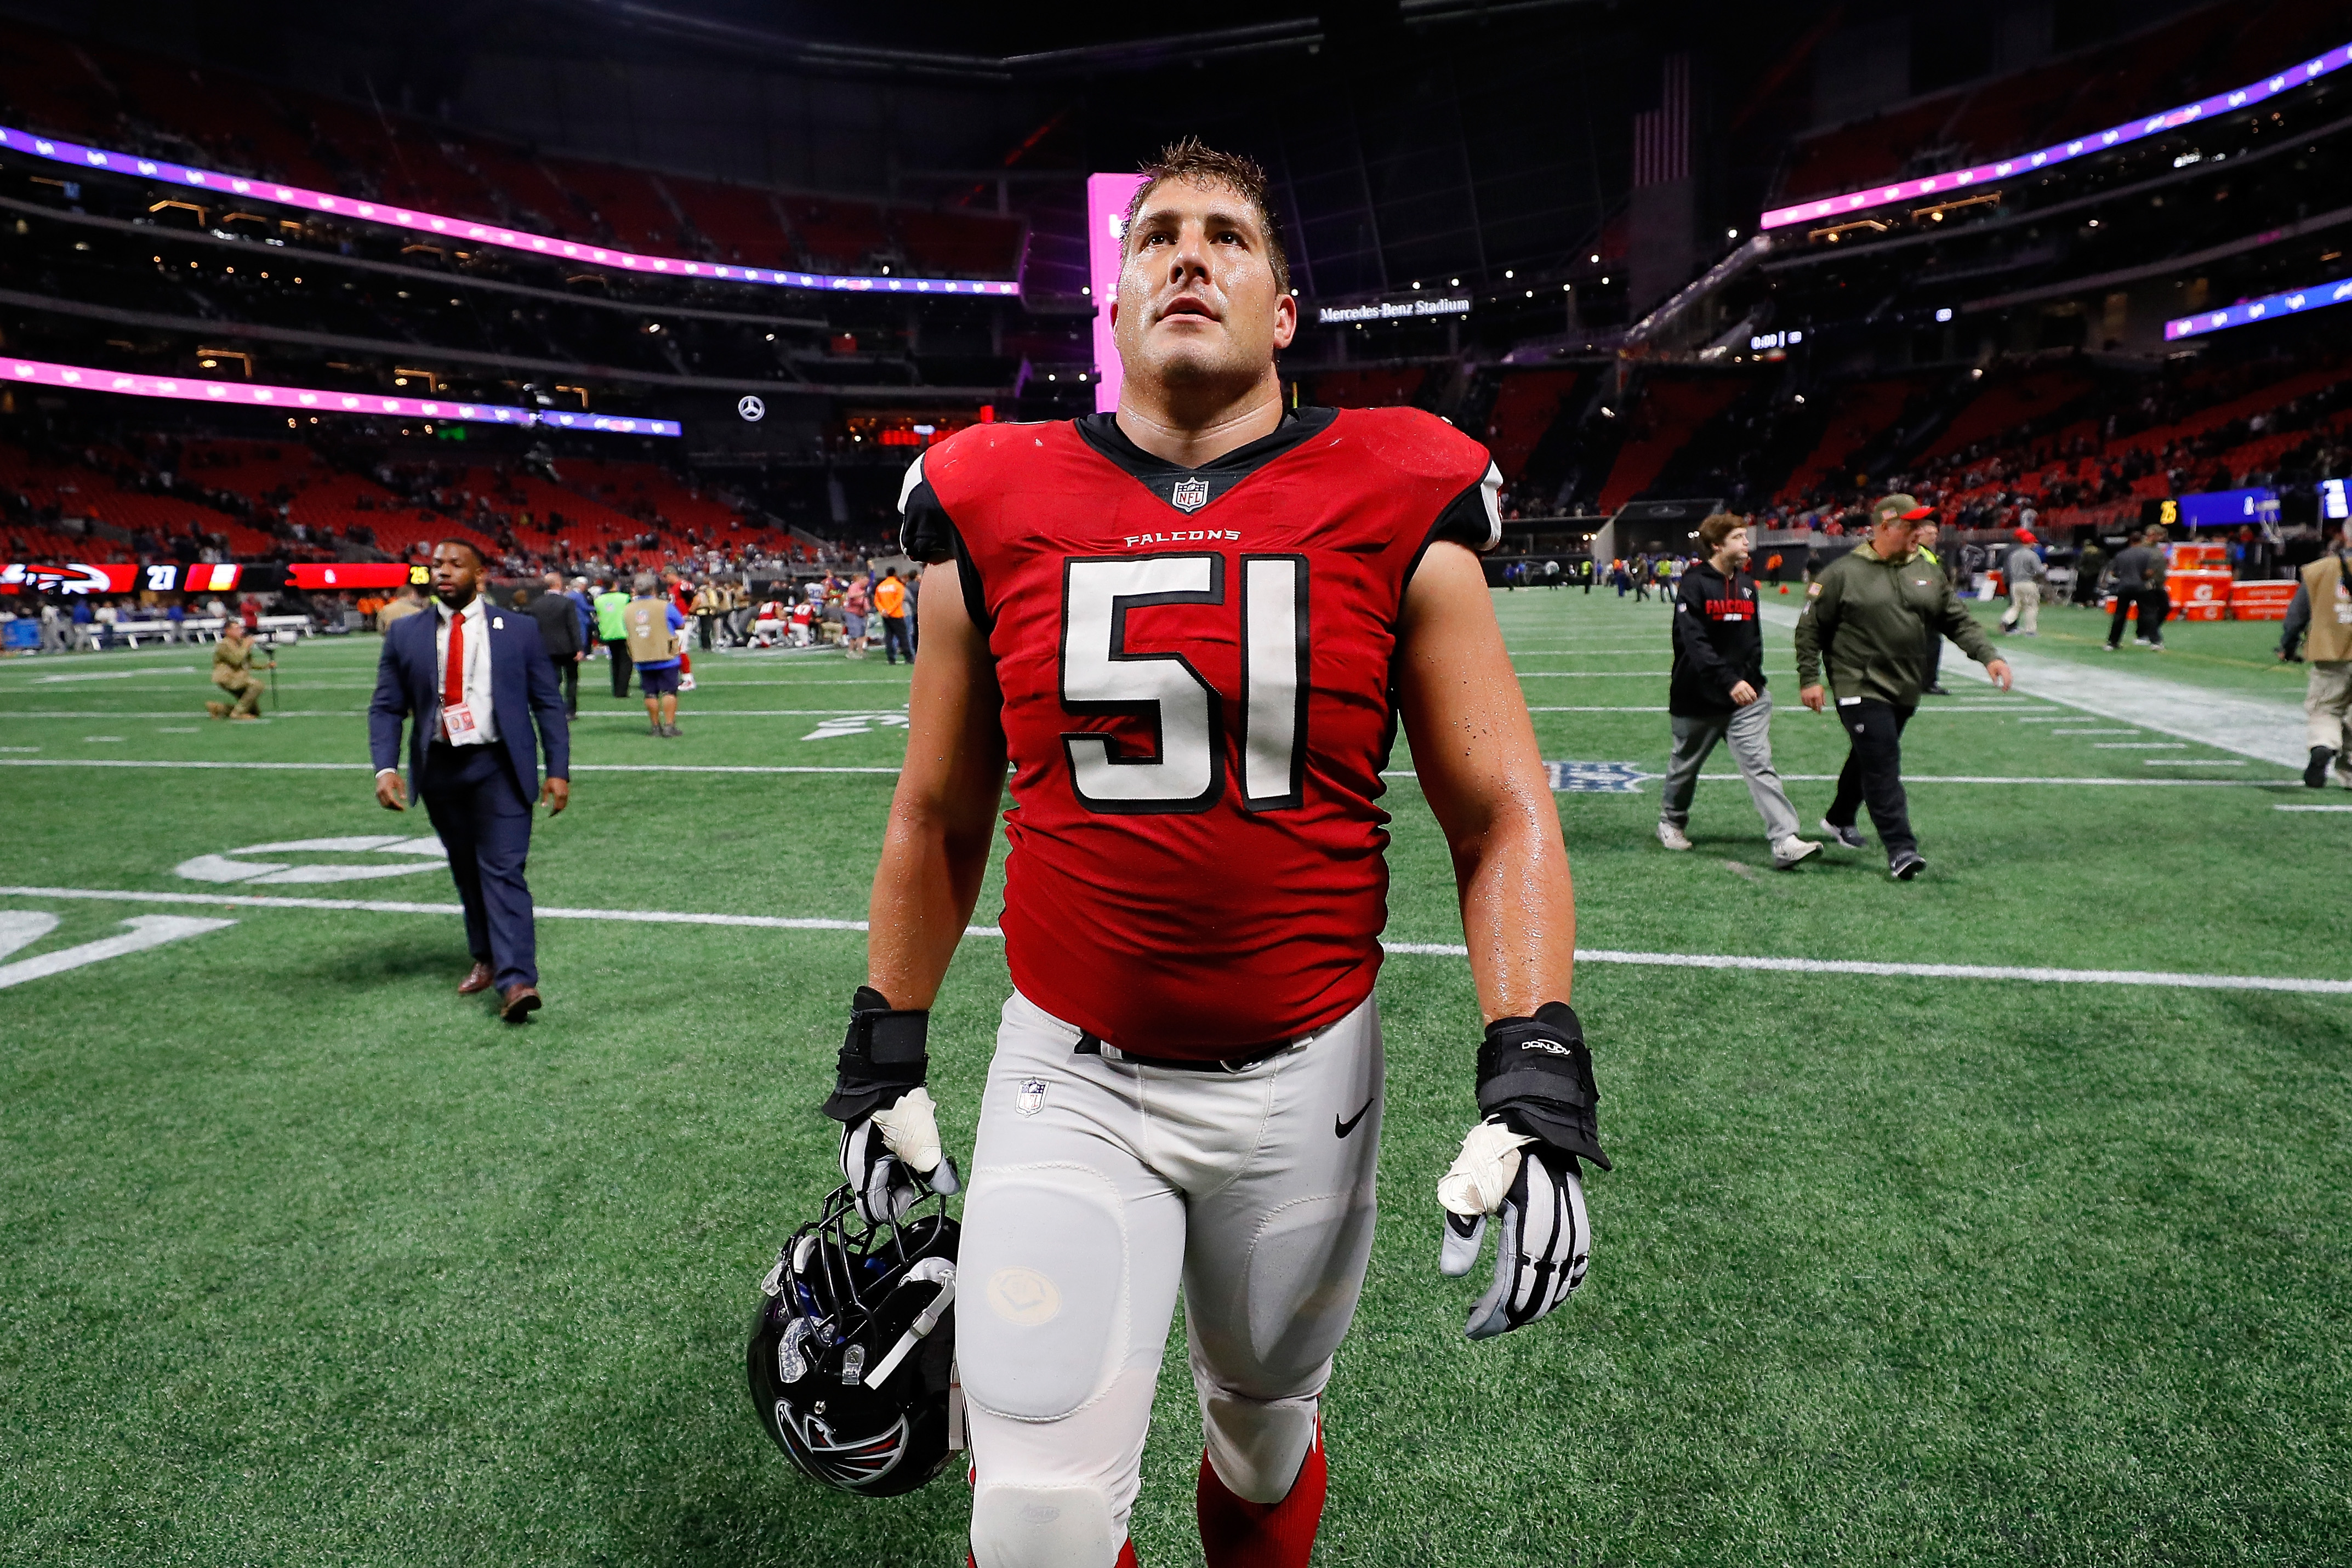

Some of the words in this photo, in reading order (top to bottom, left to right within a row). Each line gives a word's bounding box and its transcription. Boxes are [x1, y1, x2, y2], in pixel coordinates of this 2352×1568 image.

[1320, 303, 1414, 322] Mercedes-Benz
[1415, 299, 1470, 315] Stadium
[1751, 334, 1777, 350] 0:00
[1178, 492, 1201, 505] NFL
[1124, 528, 1241, 548] FALCONS
[146, 565, 177, 590] 27
[409, 566, 430, 584] 25
[1706, 600, 1755, 613] FALCONS
[1058, 551, 1310, 815] 51
[1522, 1039, 1571, 1055] DONJOY
